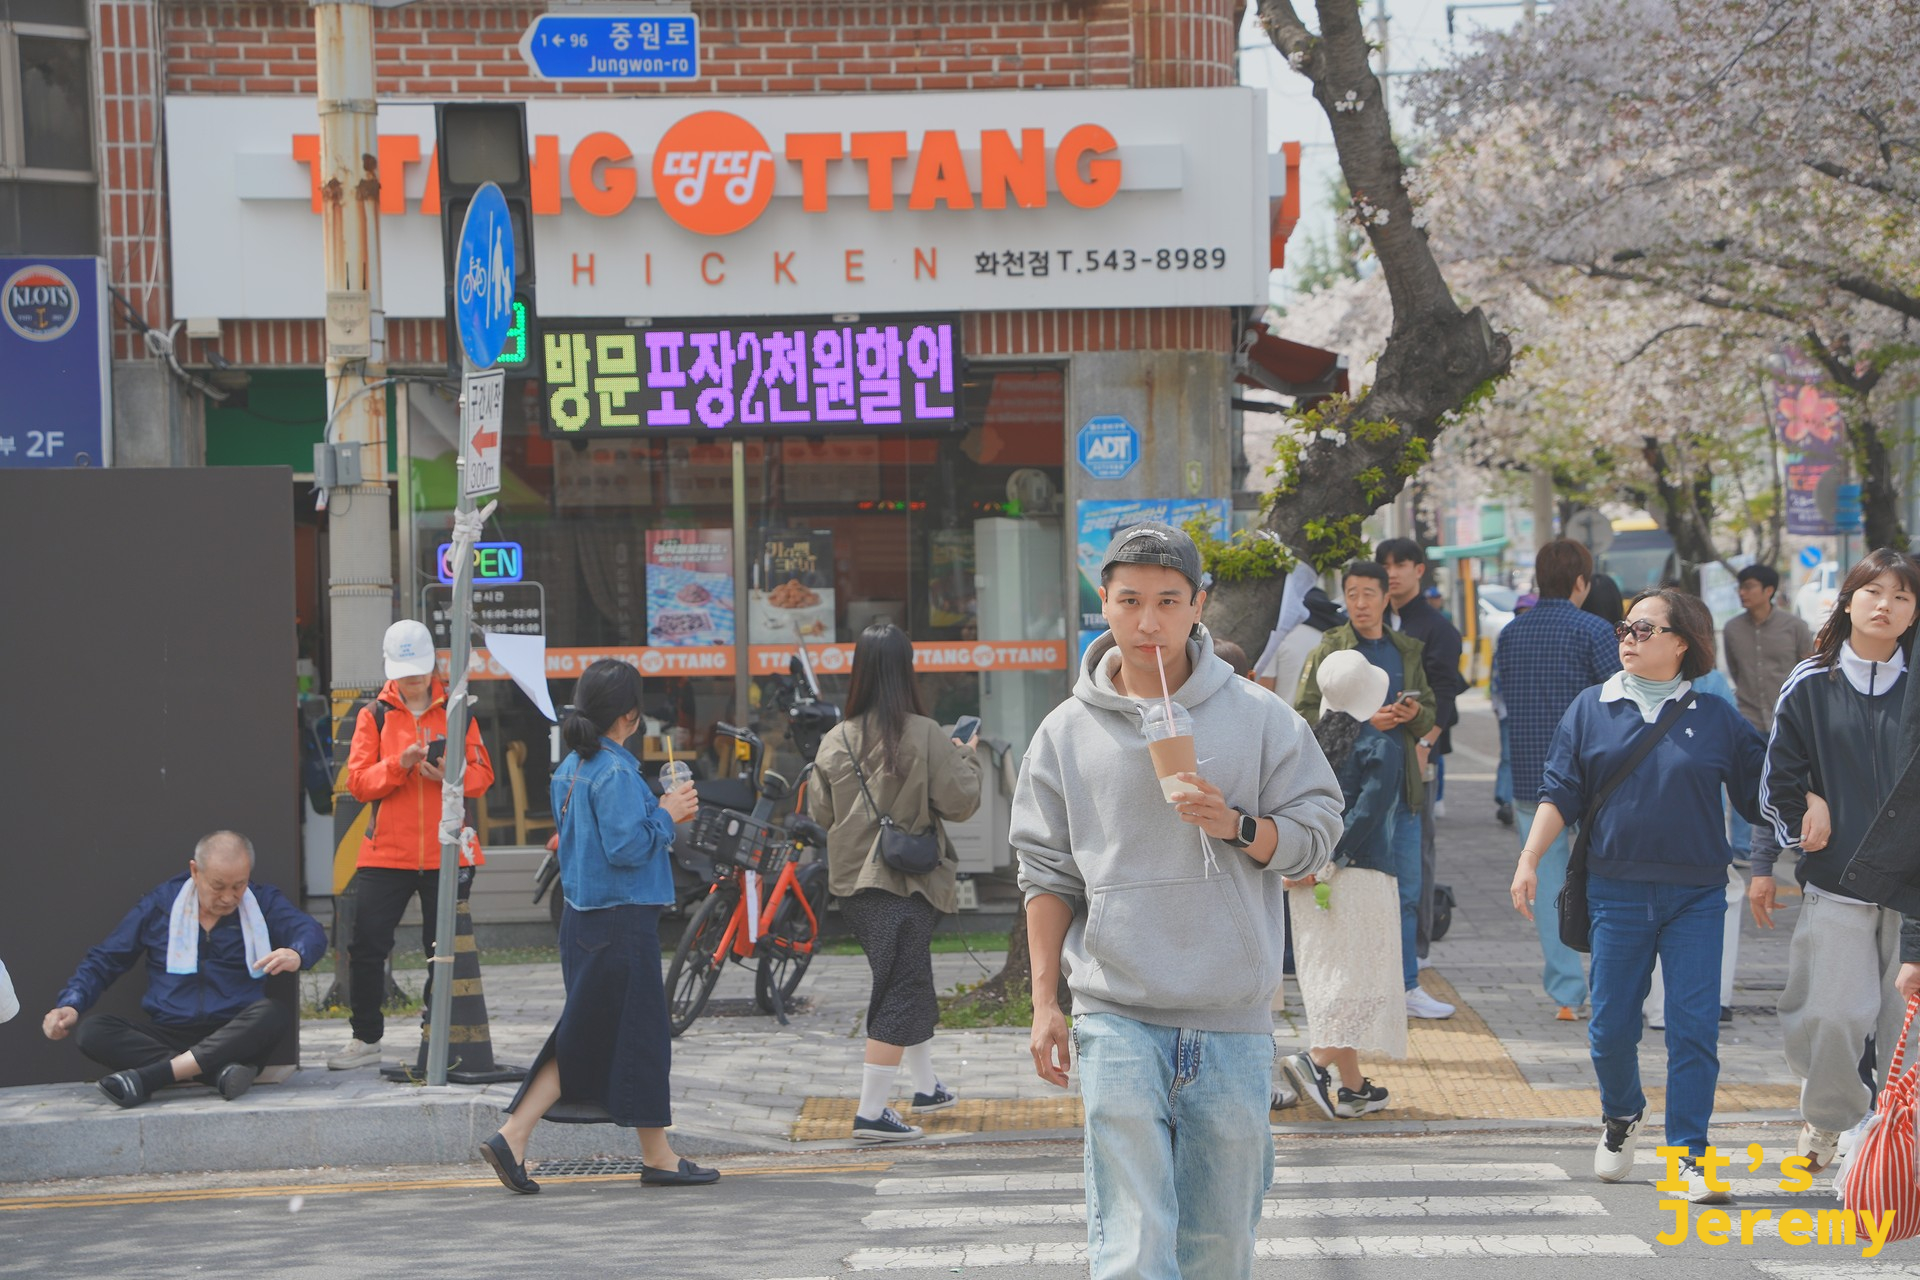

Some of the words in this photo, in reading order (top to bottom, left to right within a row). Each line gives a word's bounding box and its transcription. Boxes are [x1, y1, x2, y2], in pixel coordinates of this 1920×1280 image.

[570, 34, 588, 48] 96
[609, 22, 689, 51] 중원로
[588, 56, 689, 76] Jungwon-ro
[785, 123, 1122, 213] TTANG
[572, 247, 938, 286] HICKEN
[974, 250, 1050, 277] 화천점
[12, 286, 69, 307] KLOTS
[26, 430, 64, 458] 2F
[1087, 436, 1130, 459] ADT
[470, 463, 495, 488] 300m
[665, 652, 727, 669] TTANG
[996, 646, 1057, 663] TTANG
